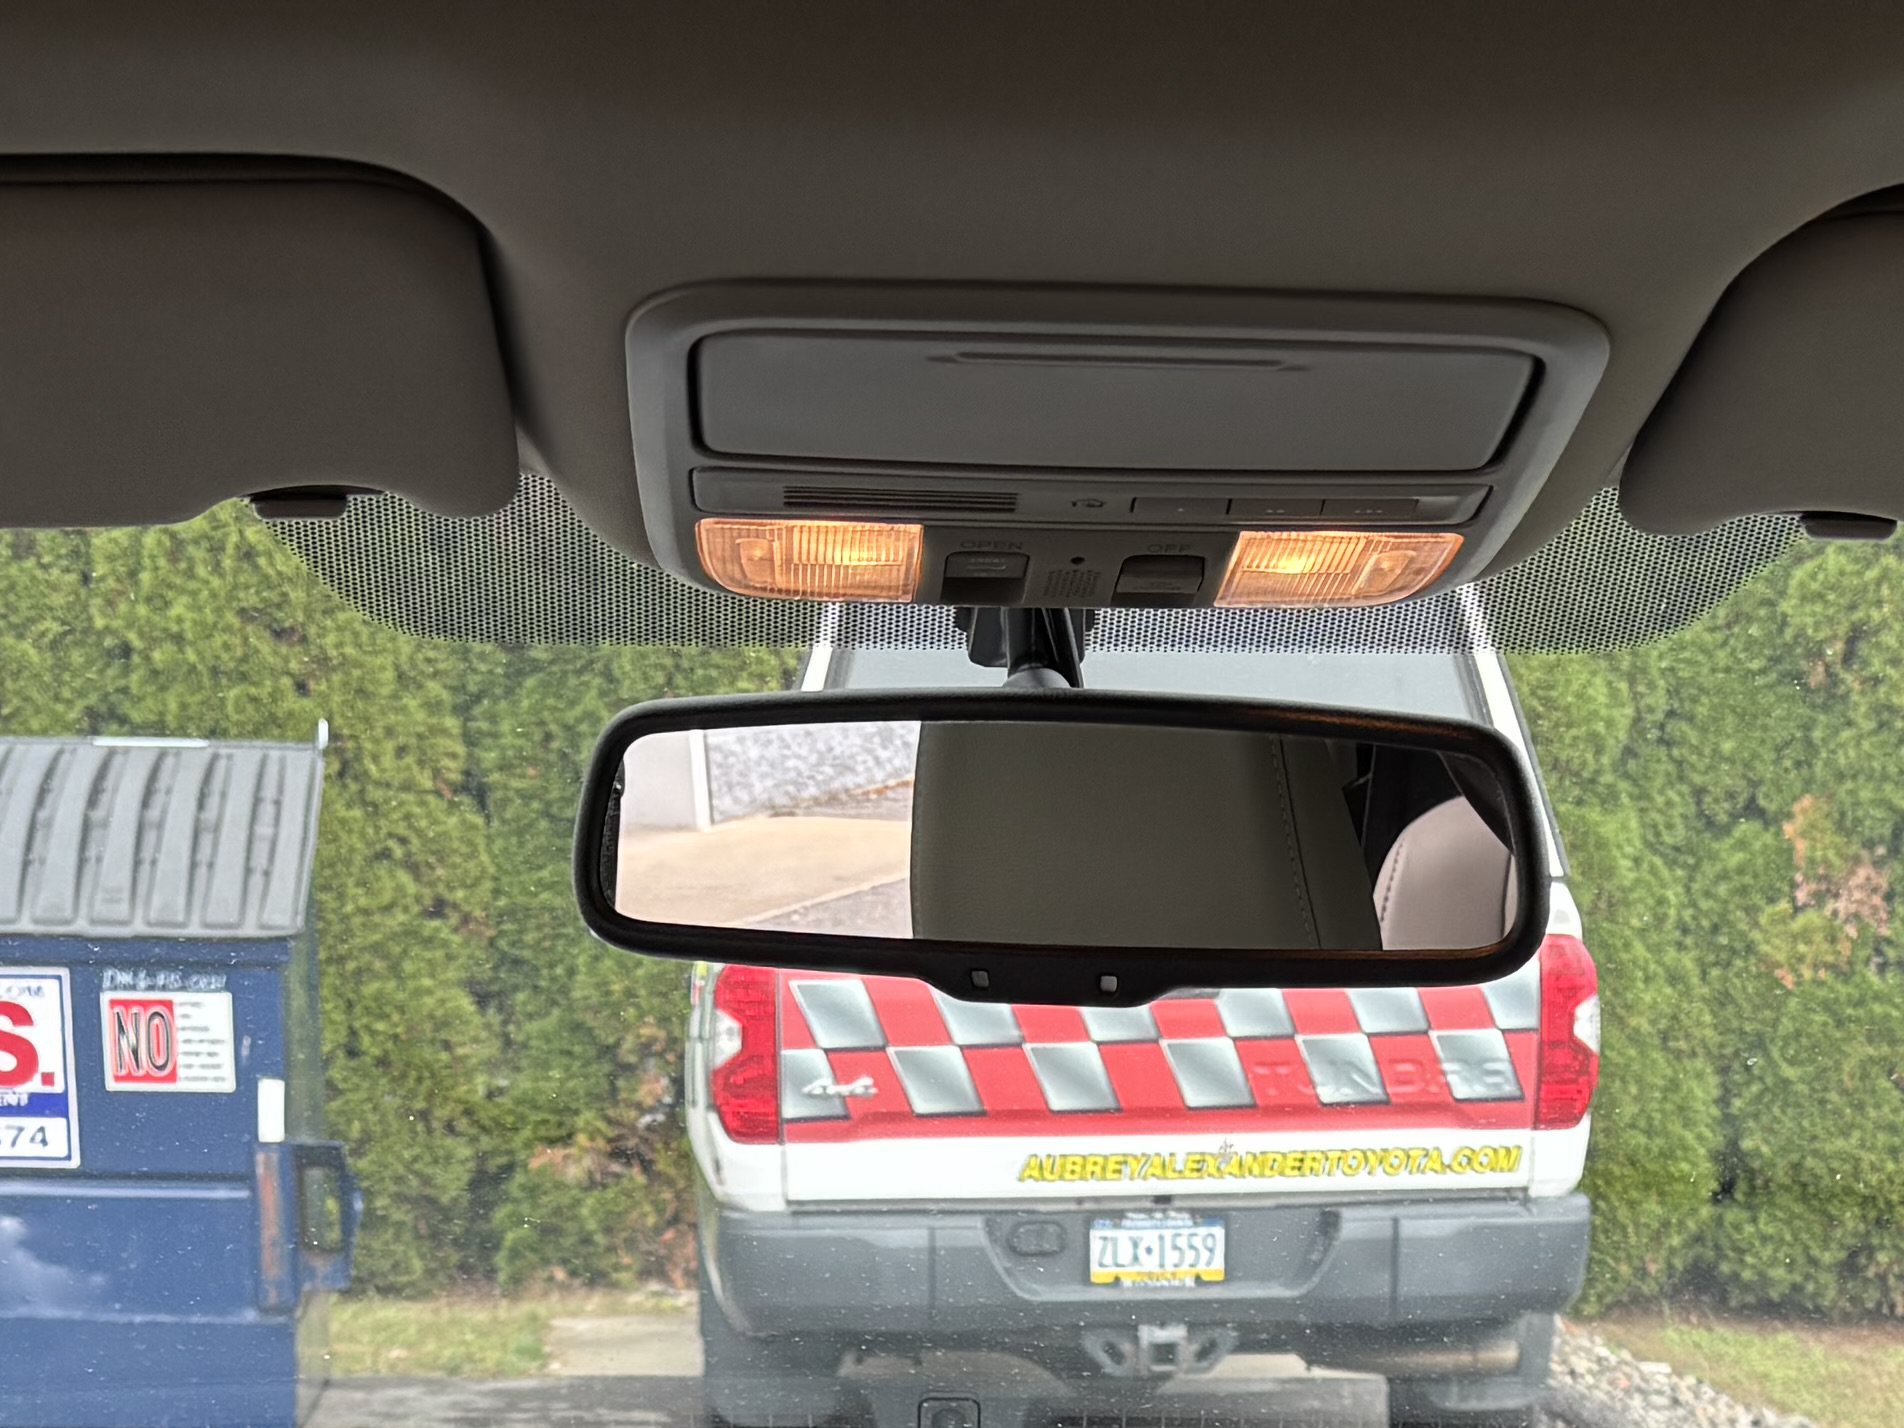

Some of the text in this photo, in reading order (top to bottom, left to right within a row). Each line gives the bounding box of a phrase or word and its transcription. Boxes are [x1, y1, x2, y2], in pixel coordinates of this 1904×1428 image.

[960, 539, 1024, 551] OPEN
[112, 1007, 174, 1077] NO
[1017, 1144, 1523, 1183] AUBREYALEXANDERTOYOTA.COM
